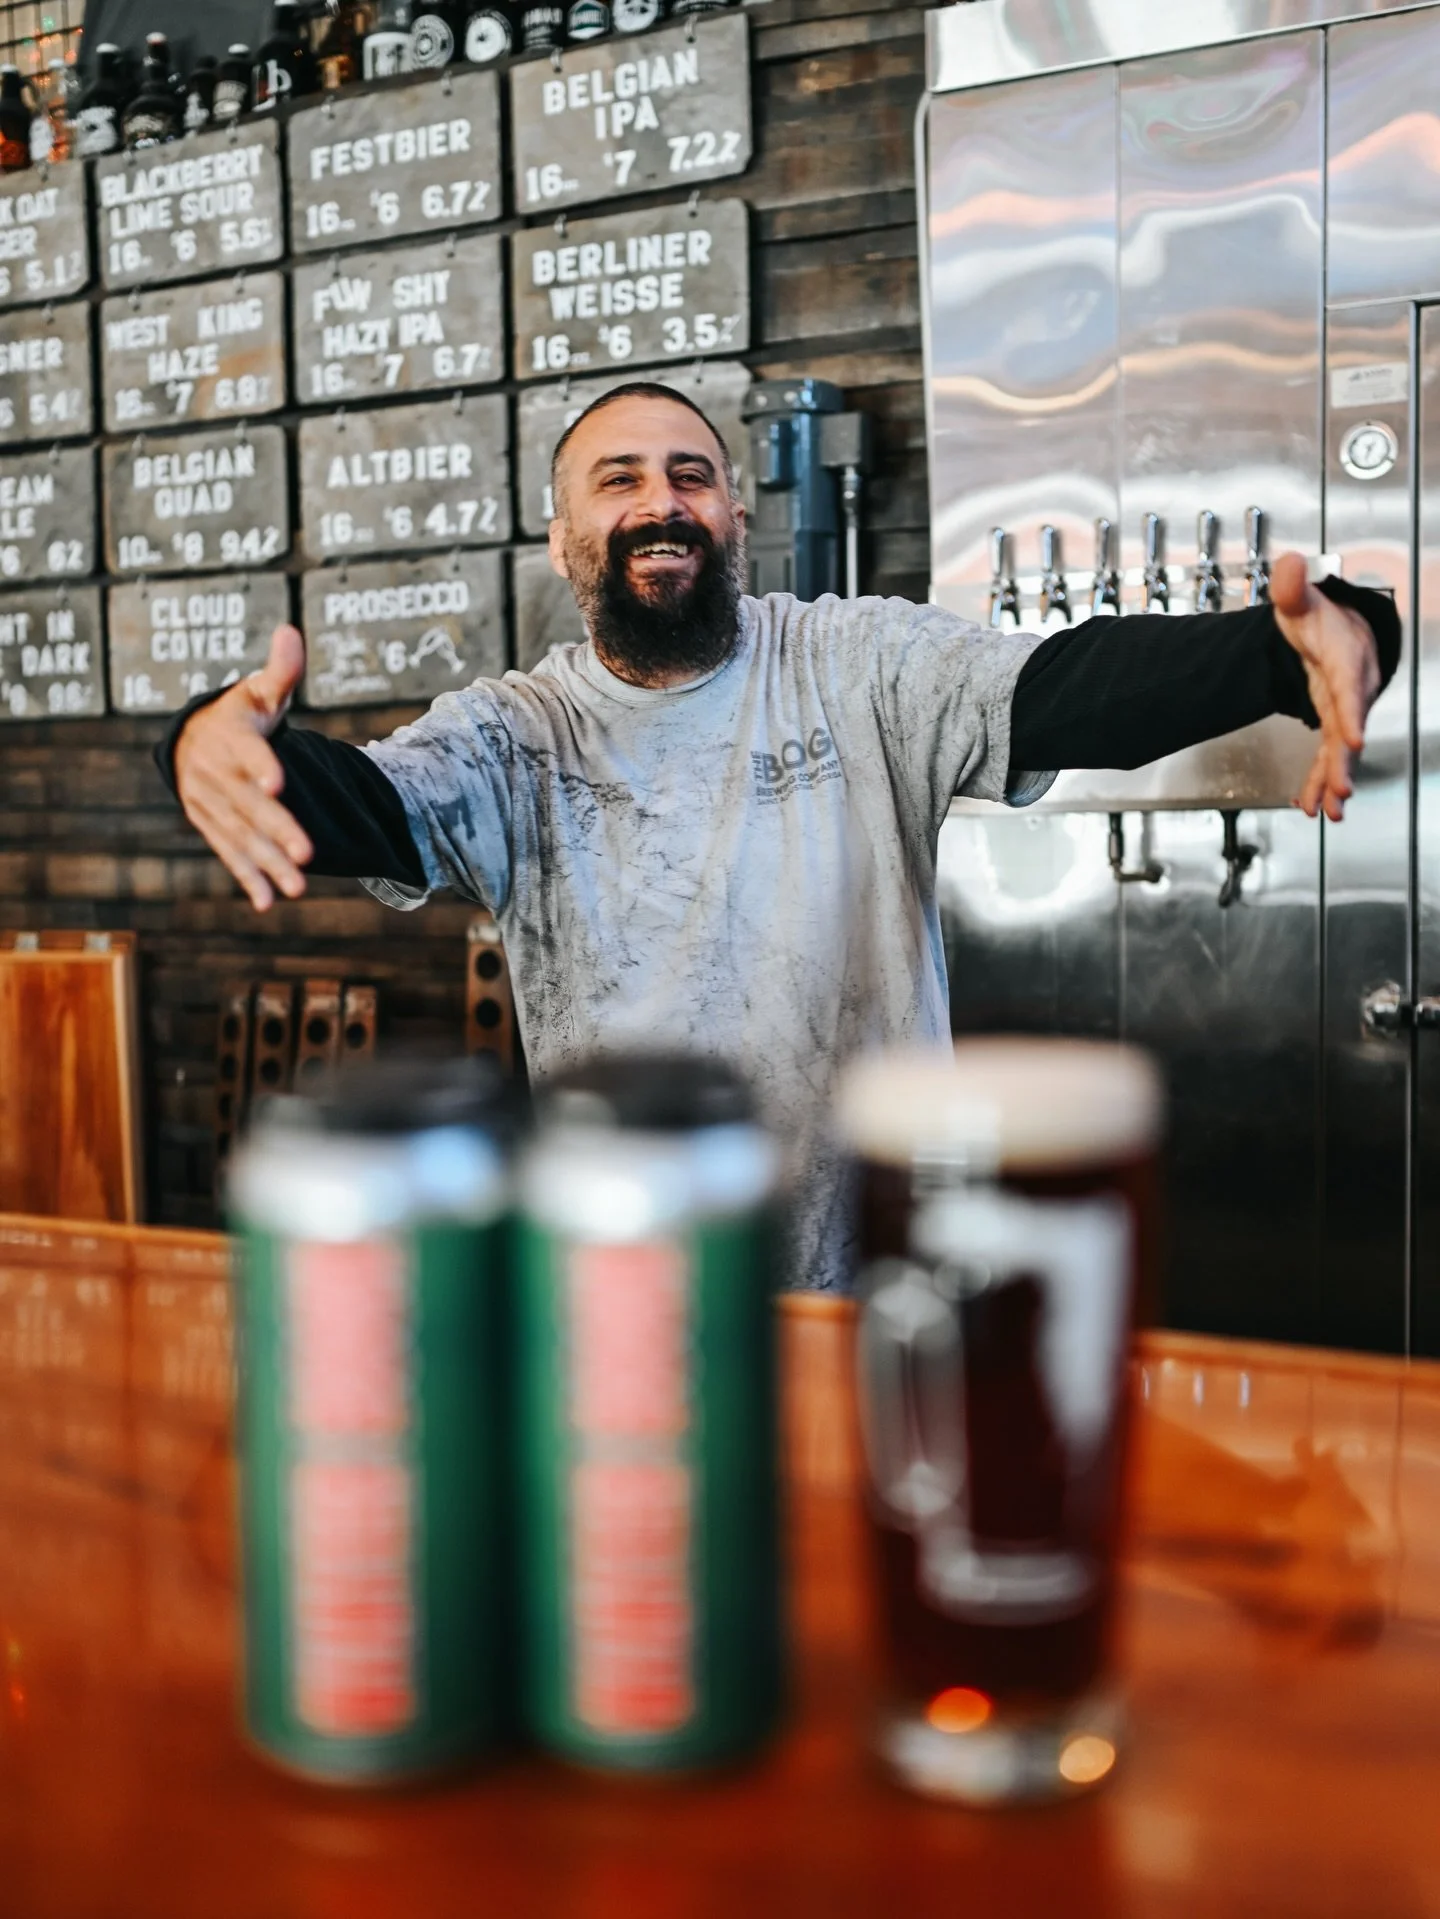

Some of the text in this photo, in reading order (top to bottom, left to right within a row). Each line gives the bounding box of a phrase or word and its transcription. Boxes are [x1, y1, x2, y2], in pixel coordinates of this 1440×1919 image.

[541, 48, 700, 116] BELGIAN
[594, 95, 659, 141] IPA
[310, 118, 472, 181] FESTBIER
[101, 143, 265, 208] BLACKBERRY
[108, 181, 255, 239] LIME SOUR
[532, 229, 712, 287] BERLINER
[197, 297, 264, 339] KING
[549, 272, 685, 321] WEISSE
[322, 310, 445, 360] HAZY IPA
[147, 342, 220, 385] HAZE
[133, 444, 255, 490] BELGIAN
[326, 443, 473, 489] ALTBIER
[153, 480, 234, 520] QUAD
[151, 592, 246, 630] CLOUD
[324, 580, 470, 626] PROSECCO
[21, 641, 91, 678] DARK
[151, 627, 246, 663] COVER
[762, 726, 833, 784] BOG
